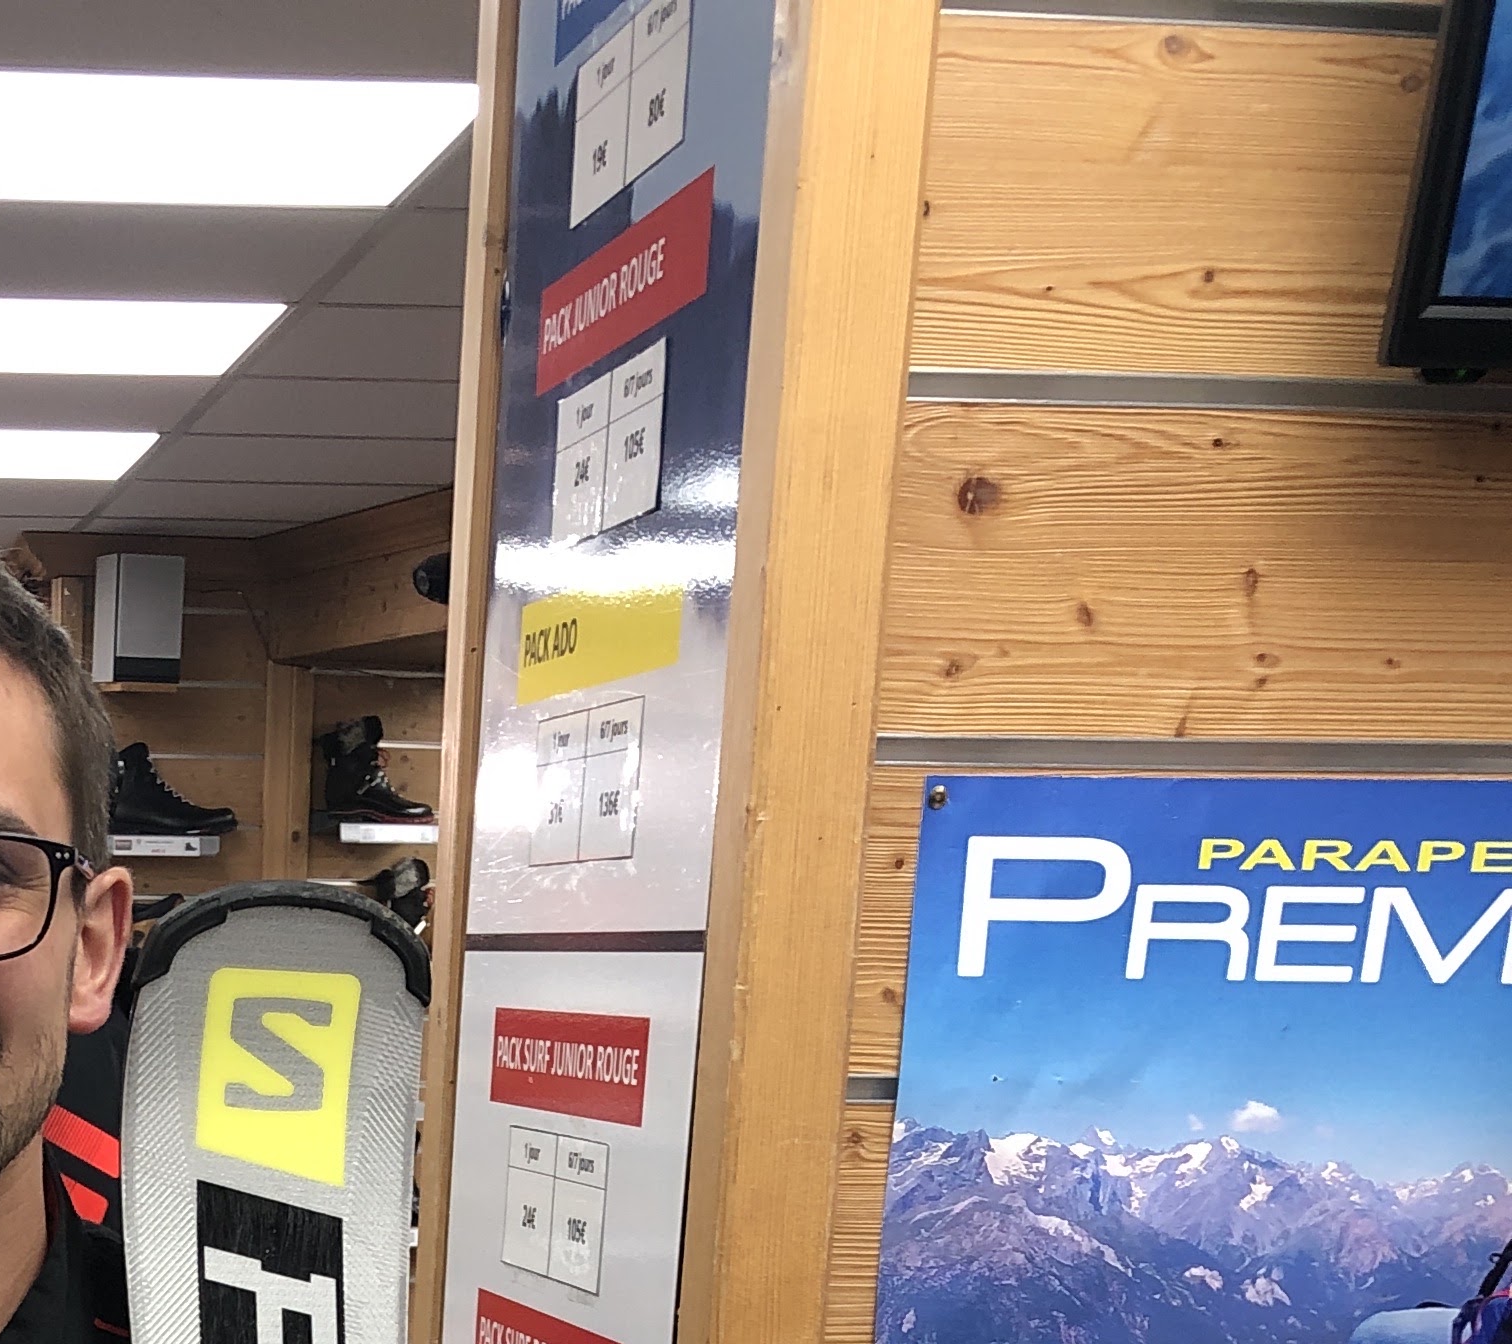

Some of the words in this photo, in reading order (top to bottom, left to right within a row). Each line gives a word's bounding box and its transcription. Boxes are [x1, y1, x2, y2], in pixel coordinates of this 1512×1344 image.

[542, 301, 573, 354] PACK
[572, 272, 617, 336] JUNIOR
[619, 237, 666, 305] ROUGE
[624, 427, 646, 462] 105€
[523, 627, 551, 668] PACK
[552, 618, 578, 658] ADO
[599, 790, 620, 817] 136€
[1197, 837, 1512, 874] PARAPE
[956, 835, 1512, 984] PREM
[496, 1036, 523, 1070] PACK
[523, 1038, 551, 1074] SURF
[551, 1041, 593, 1080] JUNIOR
[595, 1046, 640, 1086] ROUGE
